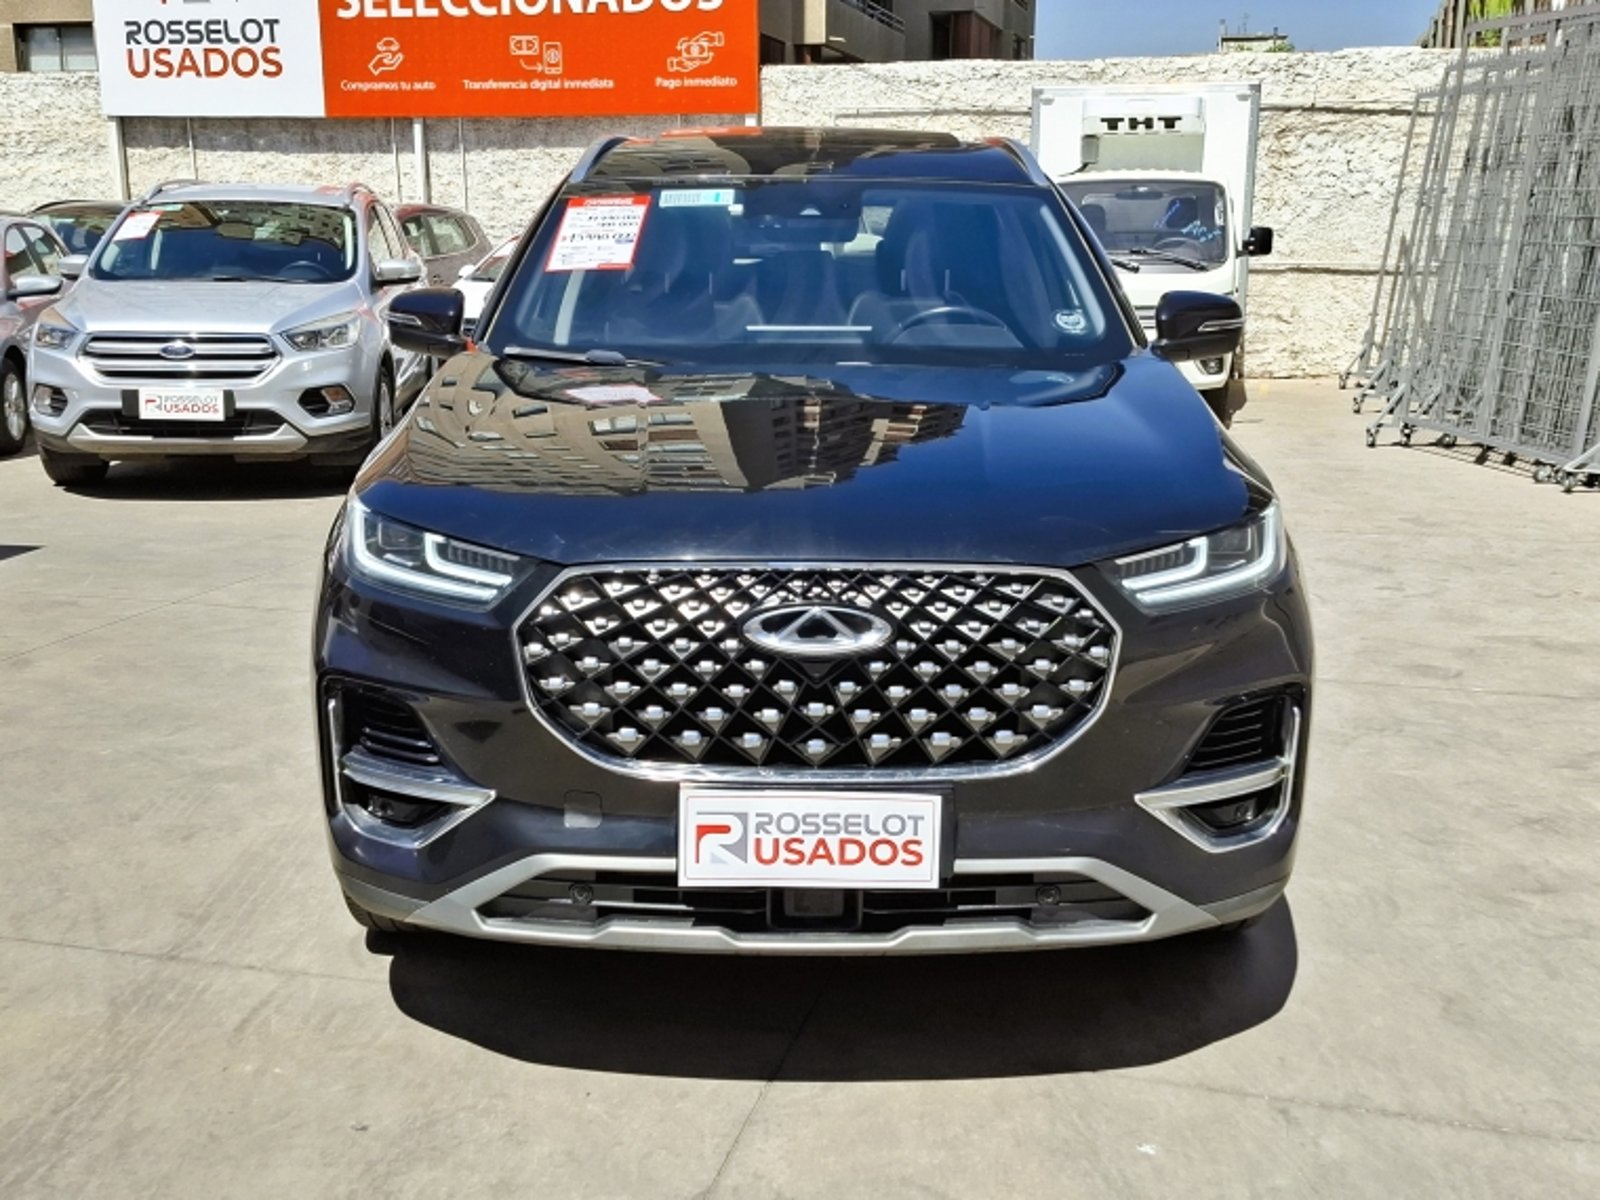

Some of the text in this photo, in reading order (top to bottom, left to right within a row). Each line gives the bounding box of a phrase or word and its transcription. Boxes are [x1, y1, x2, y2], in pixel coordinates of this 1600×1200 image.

[124, 18, 280, 45] ROSSELOT
[127, 46, 283, 79] USADOS
[340, 79, 437, 92] Compramos tu auto
[462, 77, 615, 92] Transferencia digital inmediata
[655, 75, 738, 90] Pago inmediato
[1100, 117, 1182, 131] THT
[163, 404, 220, 414] USADOS
[754, 811, 925, 837] ROSSELOT
[753, 837, 925, 867] USADOS
